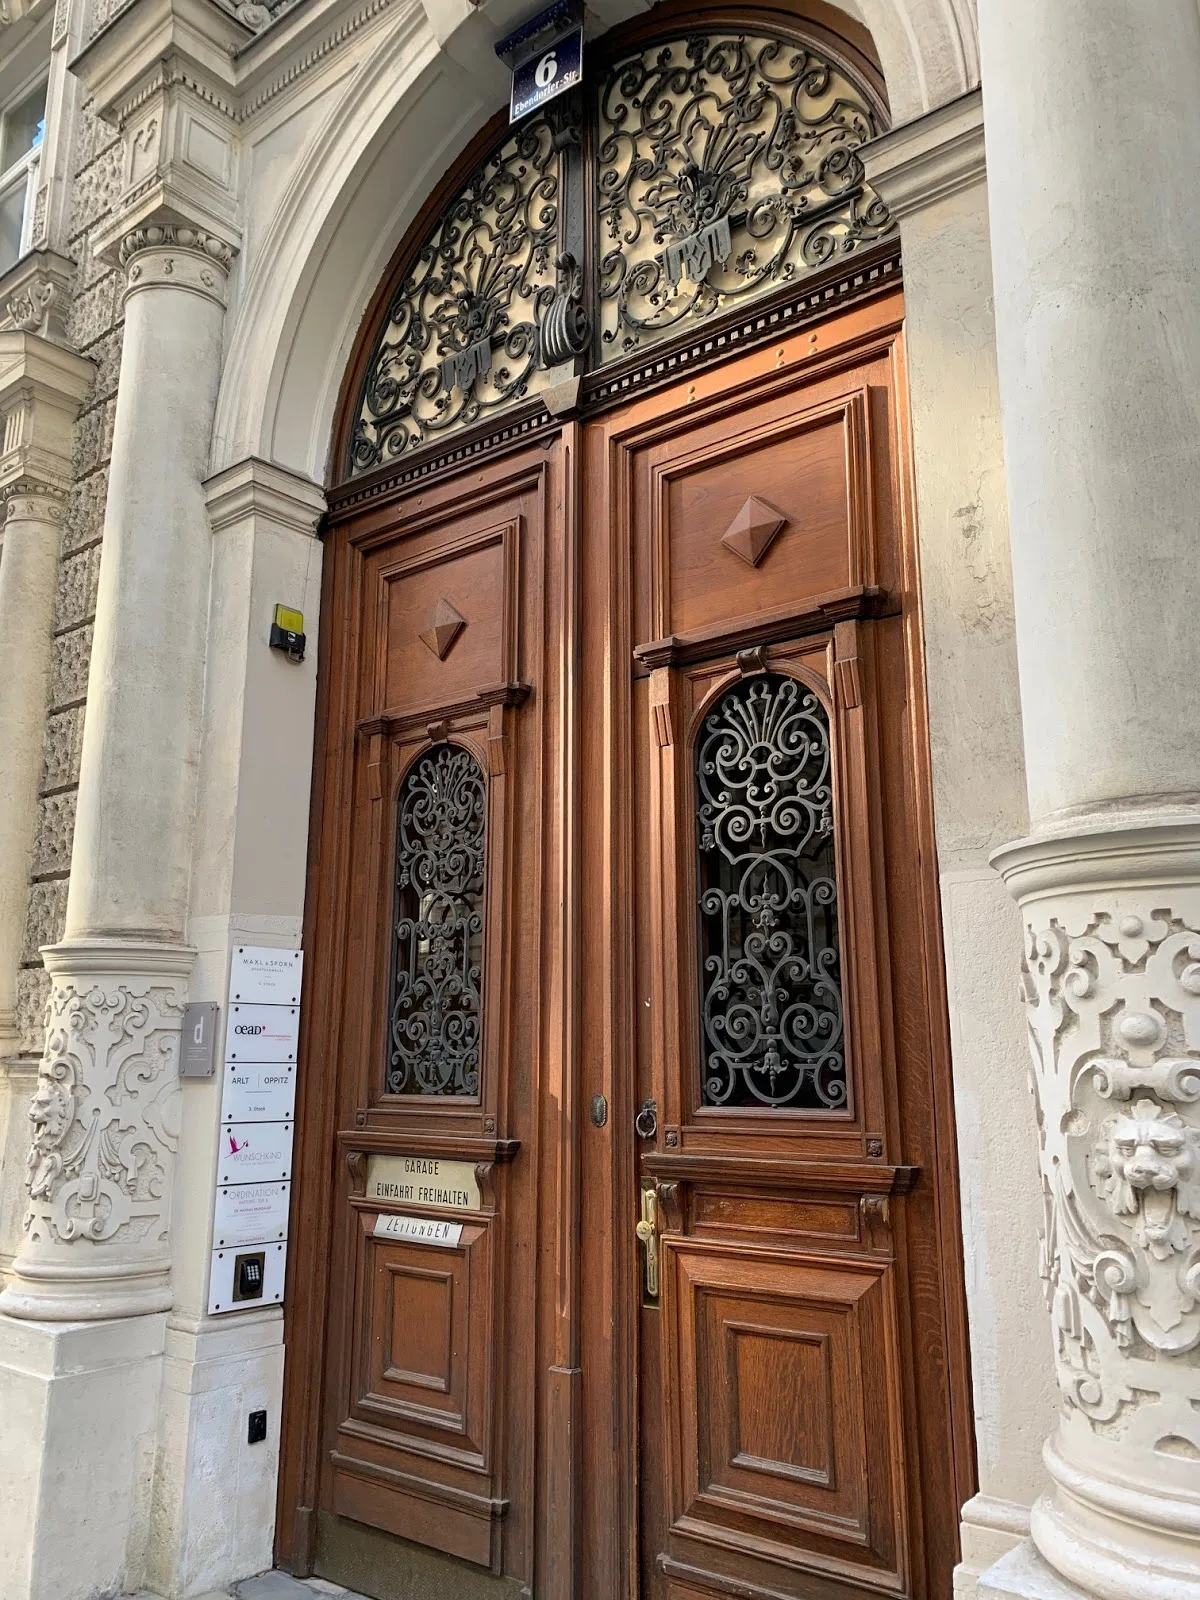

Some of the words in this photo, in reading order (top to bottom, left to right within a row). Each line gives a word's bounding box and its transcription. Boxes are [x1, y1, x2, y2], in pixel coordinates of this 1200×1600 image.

[535, 51, 557, 87] 6
[233, 1151, 282, 1162] WUNSCHKIND
[405, 1159, 439, 1175] GARAGE
[229, 1188, 279, 1200] ORDINATION
[377, 1183, 413, 1199] EINFAHRT
[418, 1187, 468, 1205] FREIHALTEN
[386, 1218, 450, 1238] ZEITUNGEN
